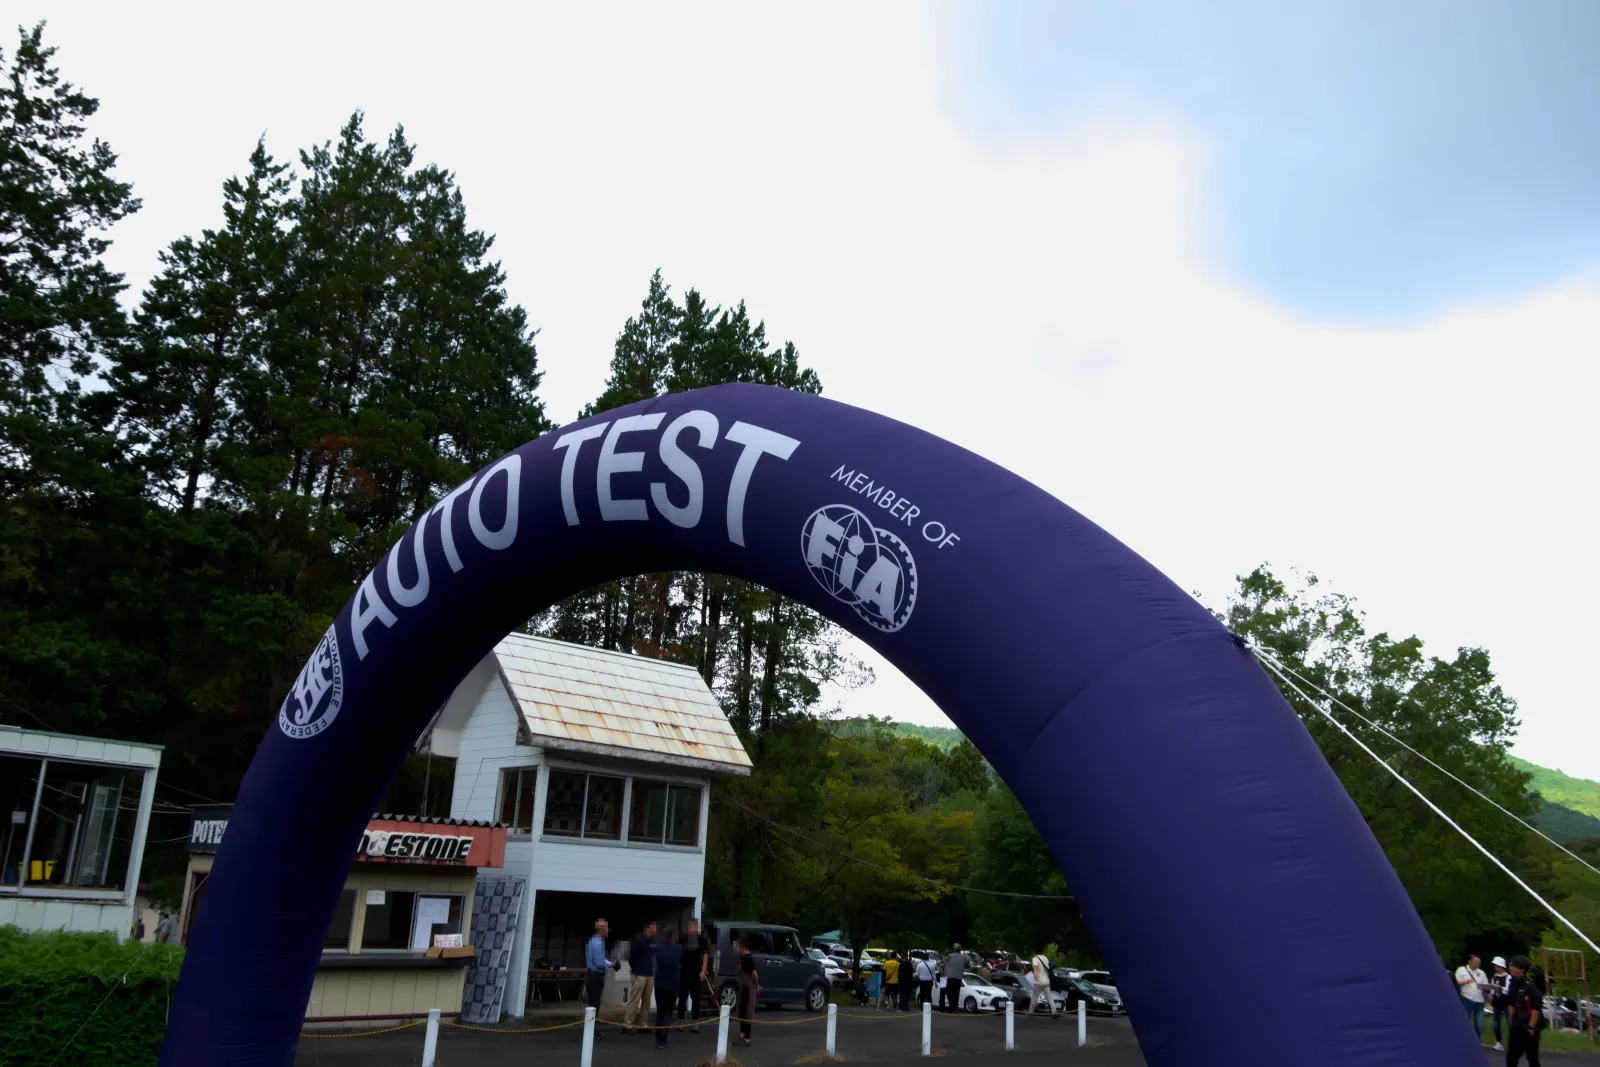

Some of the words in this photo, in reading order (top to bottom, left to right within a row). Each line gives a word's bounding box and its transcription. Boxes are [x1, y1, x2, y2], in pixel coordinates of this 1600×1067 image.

[351, 454, 521, 661] AUTO
[553, 410, 801, 548] TEST
[830, 464, 921, 526] MEMBER
[922, 521, 960, 549] OF
[328, 626, 342, 709] UTOMOBILE
